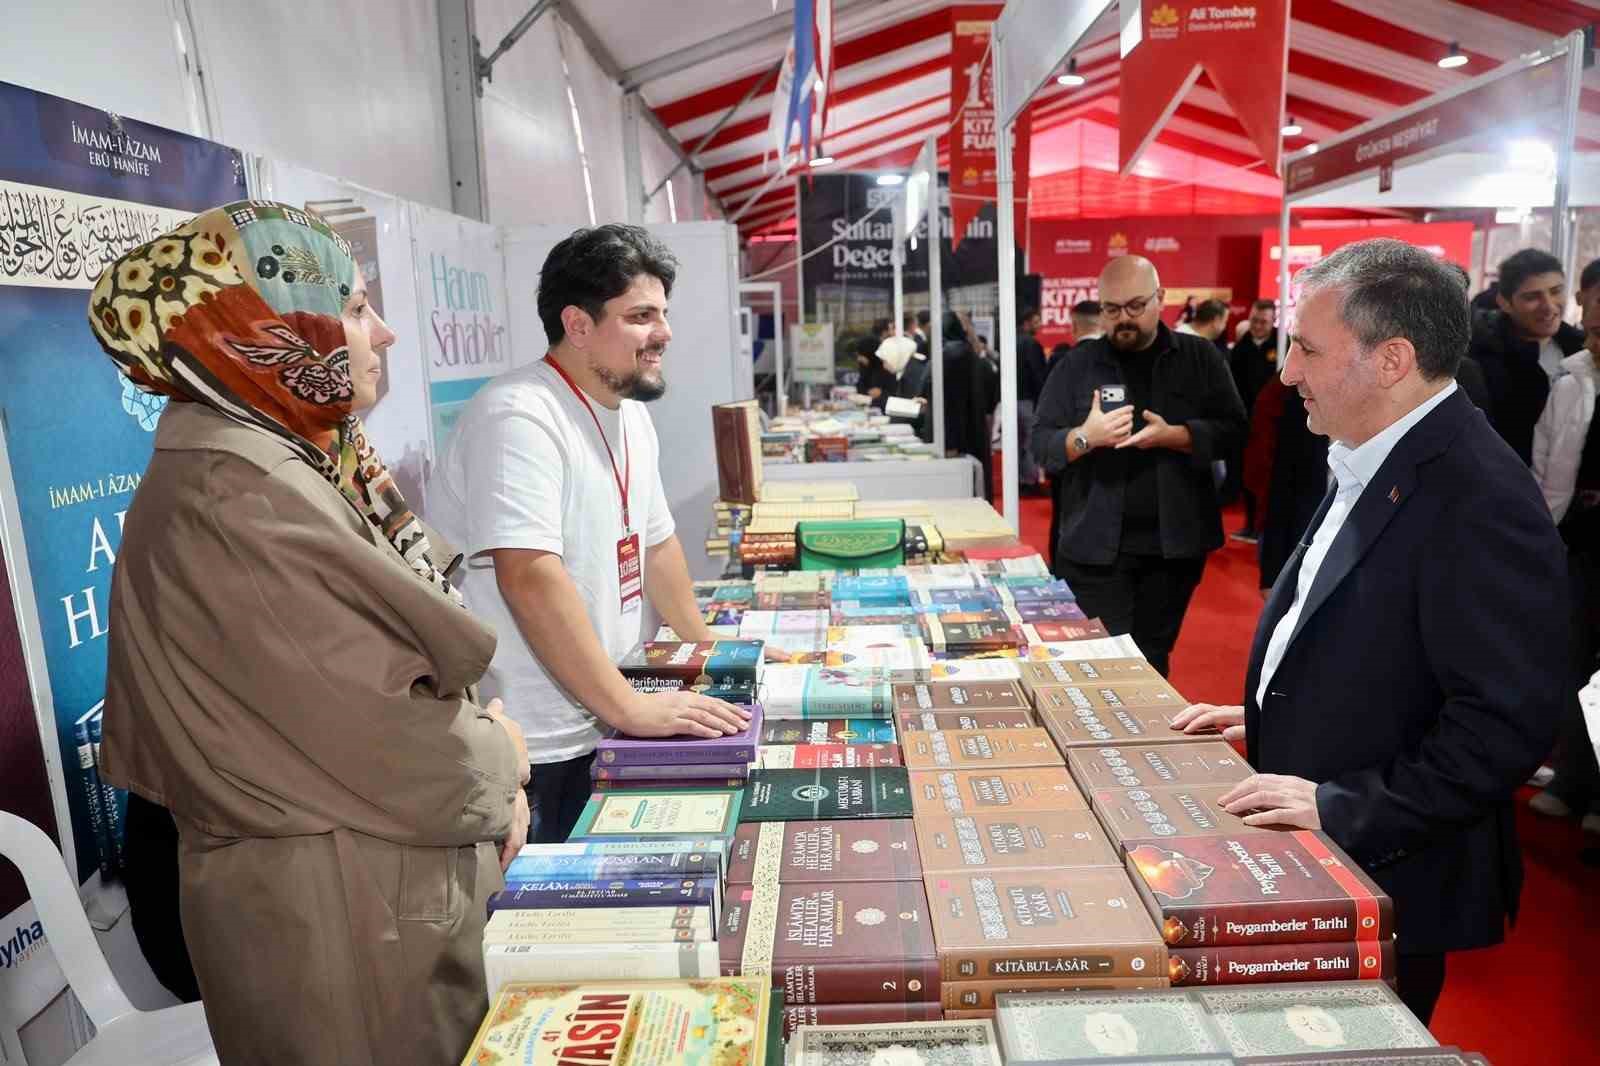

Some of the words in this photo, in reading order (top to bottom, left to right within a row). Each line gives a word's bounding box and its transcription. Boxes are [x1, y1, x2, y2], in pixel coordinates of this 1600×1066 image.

[786, 896, 806, 942] İSLÂM'DA
[803, 897, 819, 947] HELALLER
[819, 889, 834, 948] HARAMLAR
[1226, 919, 1308, 939] Peygamberler
[1311, 917, 1348, 930] Tarihi
[1228, 960, 1310, 977] Peygamberler
[1314, 957, 1350, 970] Tarihi
[882, 981, 897, 991] 2
